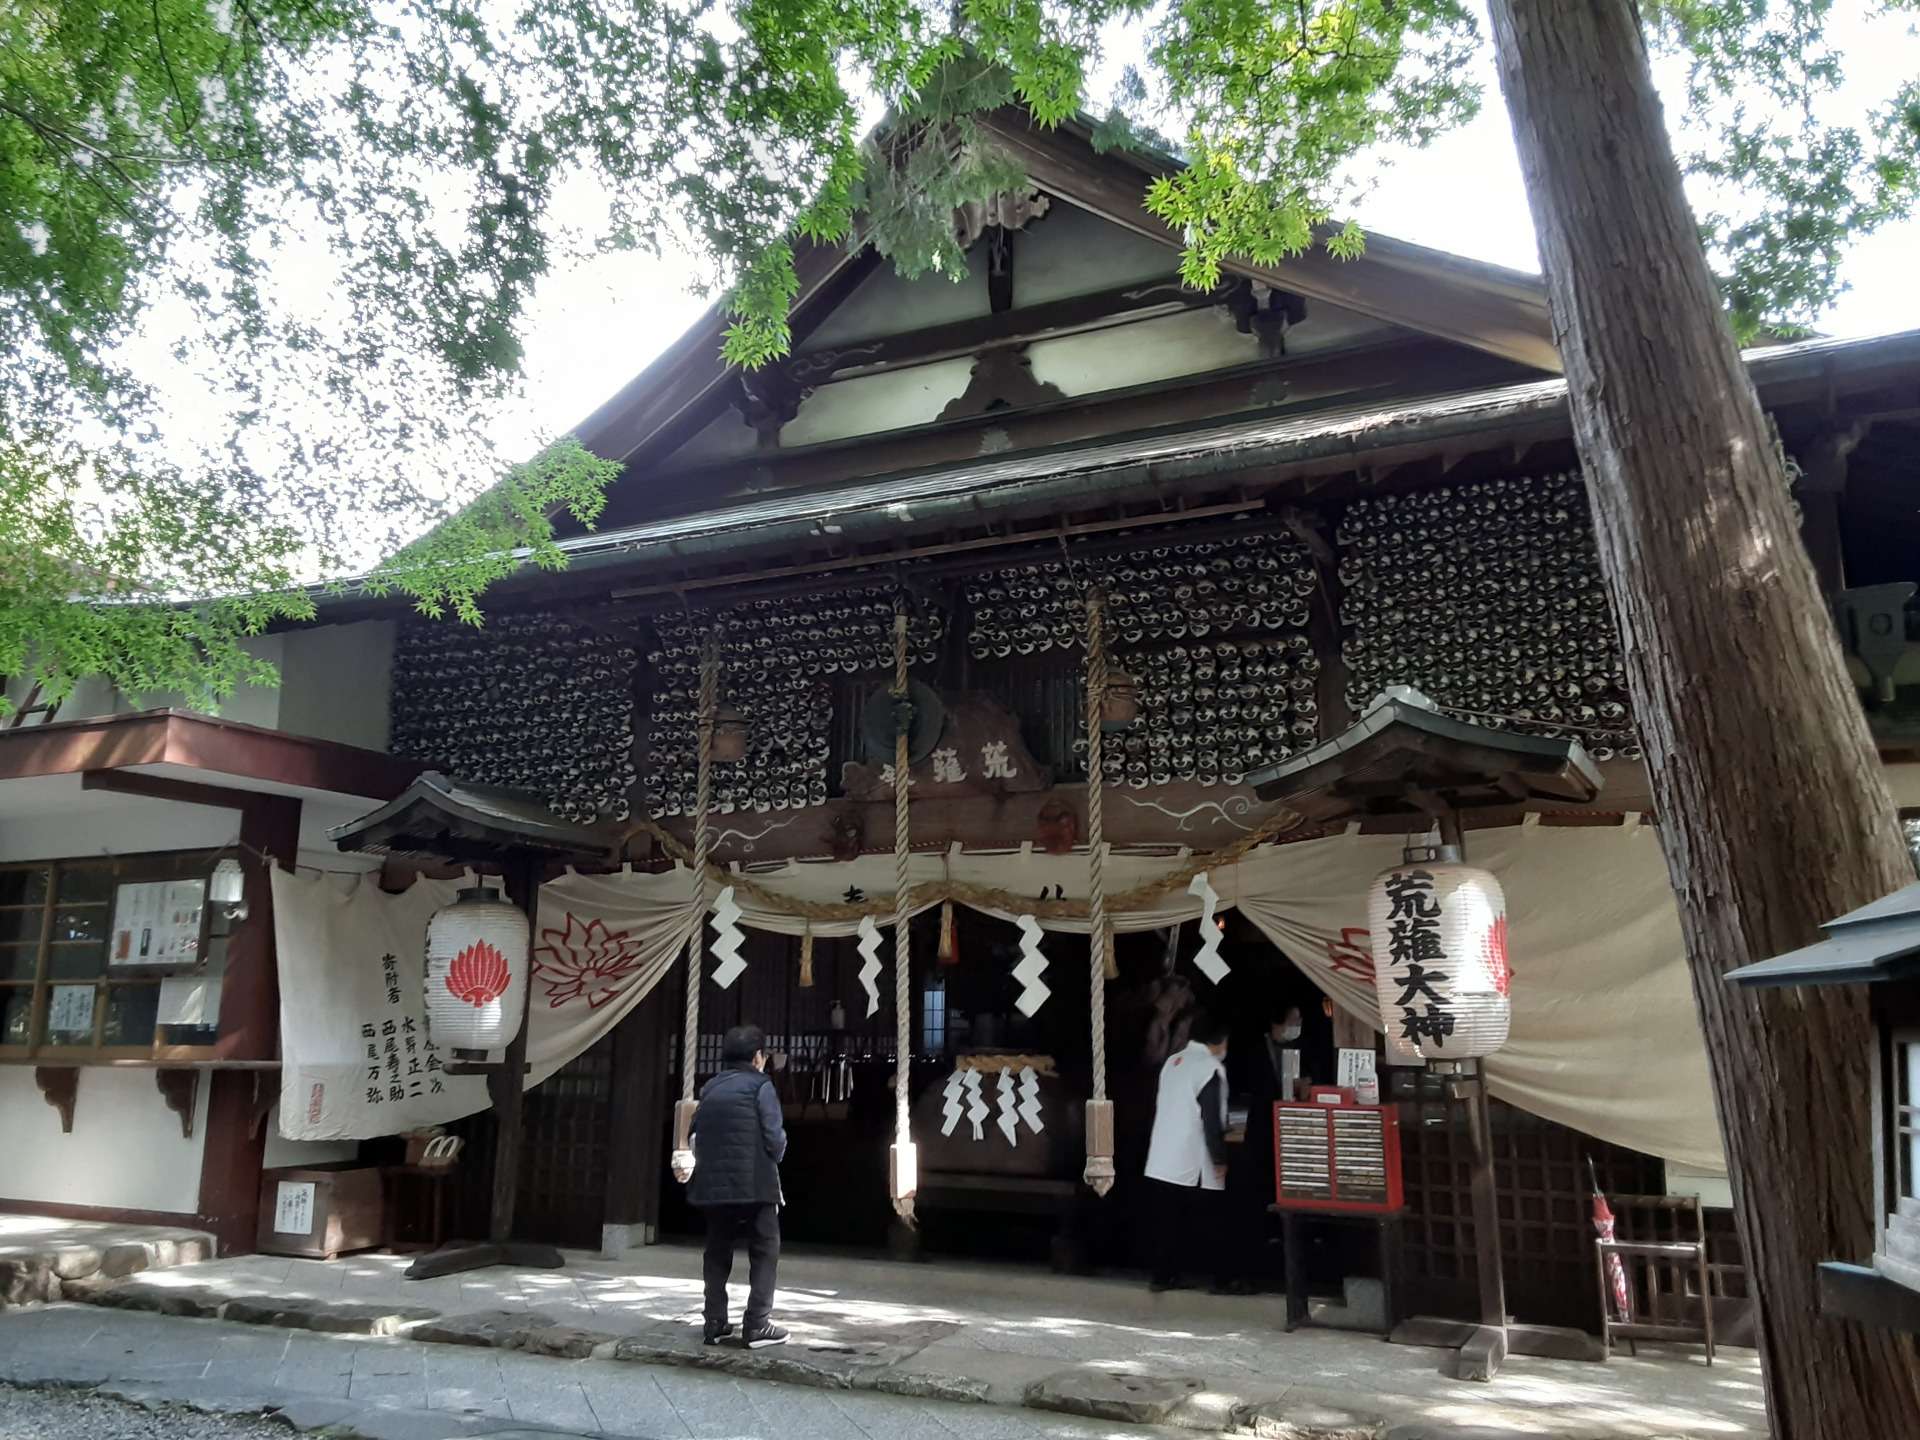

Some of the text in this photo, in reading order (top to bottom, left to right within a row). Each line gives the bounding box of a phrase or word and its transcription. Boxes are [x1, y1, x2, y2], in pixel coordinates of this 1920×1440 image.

[381, 952, 403, 1005] 寄附者
[1384, 869, 1456, 1049] 荒薙大神
